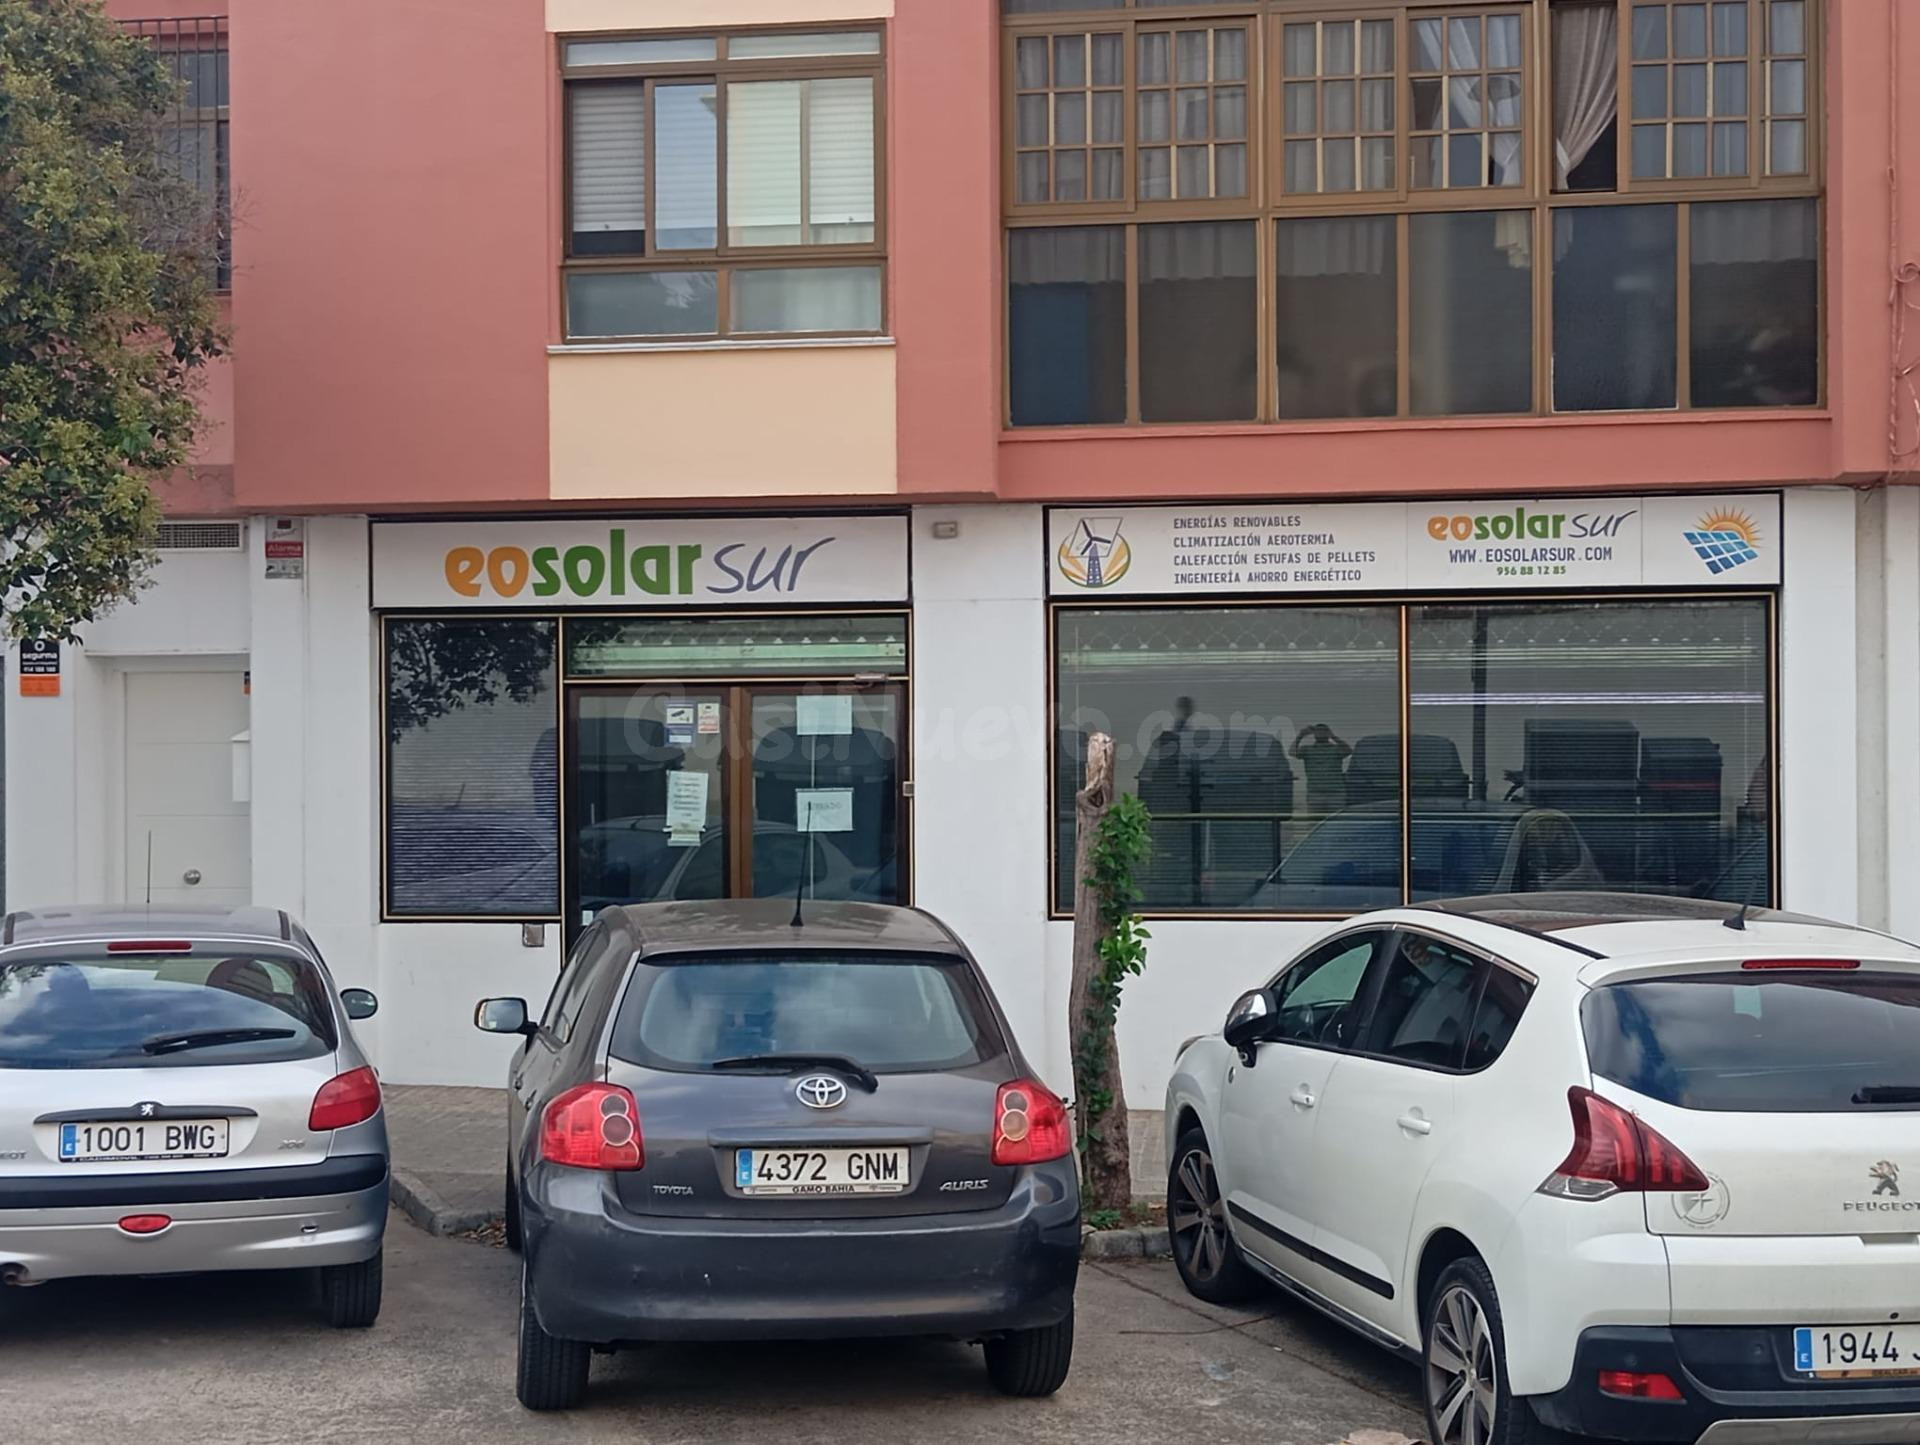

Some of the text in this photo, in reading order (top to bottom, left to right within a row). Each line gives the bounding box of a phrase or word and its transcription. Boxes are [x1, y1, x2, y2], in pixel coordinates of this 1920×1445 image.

[1173, 515, 1301, 529] ENERGÍAS RENOVABLES
[1173, 533, 1335, 548] CLIMATIZACIÓN AEROTERMIA
[1173, 551, 1376, 566] CALEFACCIÓN ESTUFAS DE PELLETS
[1174, 568, 1362, 585] INGENIERÍA AHORRO ENERGÉTICO
[1496, 565, 1567, 576] 956 88 12 85
[84, 1126, 145, 1153] 1001
[165, 1125, 216, 1151] BWG
[757, 1153, 828, 1182] 4372
[847, 1152, 899, 1181] GNM
[653, 1185, 694, 1195] TOYOTA
[792, 1184, 855, 1194] GAMO BAHIA
[939, 1179, 990, 1191] AURIS
[1823, 1331, 1899, 1364] 1944
